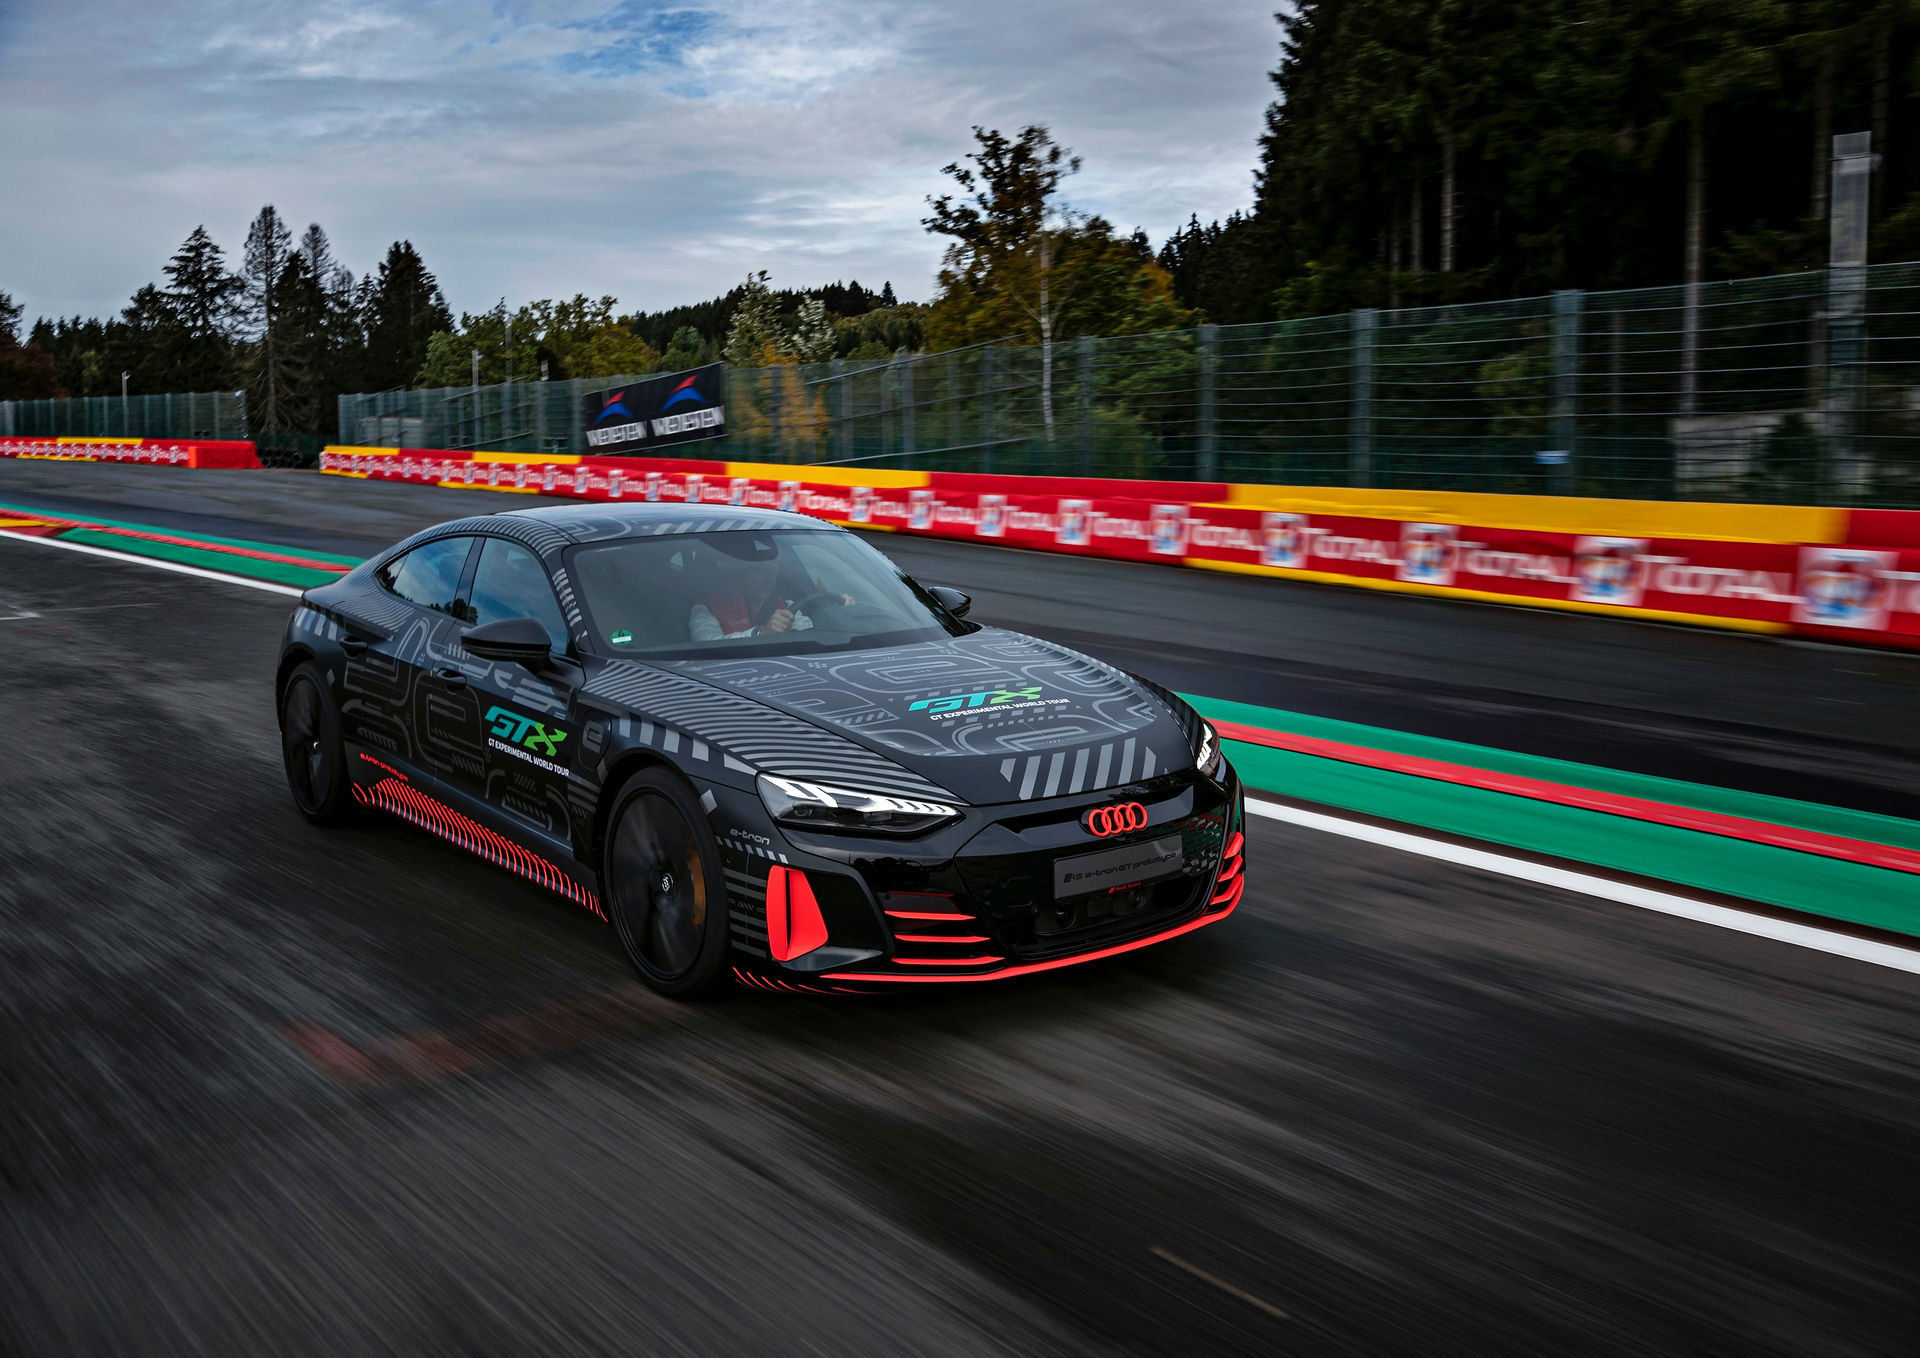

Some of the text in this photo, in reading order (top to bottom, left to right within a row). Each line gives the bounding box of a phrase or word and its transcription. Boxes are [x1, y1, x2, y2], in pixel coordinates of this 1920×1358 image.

[797, 490, 853, 513] TOTAL
[1084, 511, 1156, 540] TOTAL
[1182, 518, 1267, 551] TOTAL
[1299, 527, 1405, 566] TOTAL
[1446, 541, 1580, 584] TOTAL
[1631, 554, 1806, 604] TOTAL
[943, 705, 1014, 718] EXPERIMENTAL
[1012, 700, 1046, 709] WORLD
[495, 740, 533, 763] EXPERIMENTAL
[533, 756, 554, 771] WORLD
[554, 763, 570, 777] TOUR
[730, 828, 770, 845] e-tron
[1085, 867, 1118, 878] e-tron
[1118, 863, 1132, 872] GT
[1132, 852, 1177, 869] prototype
